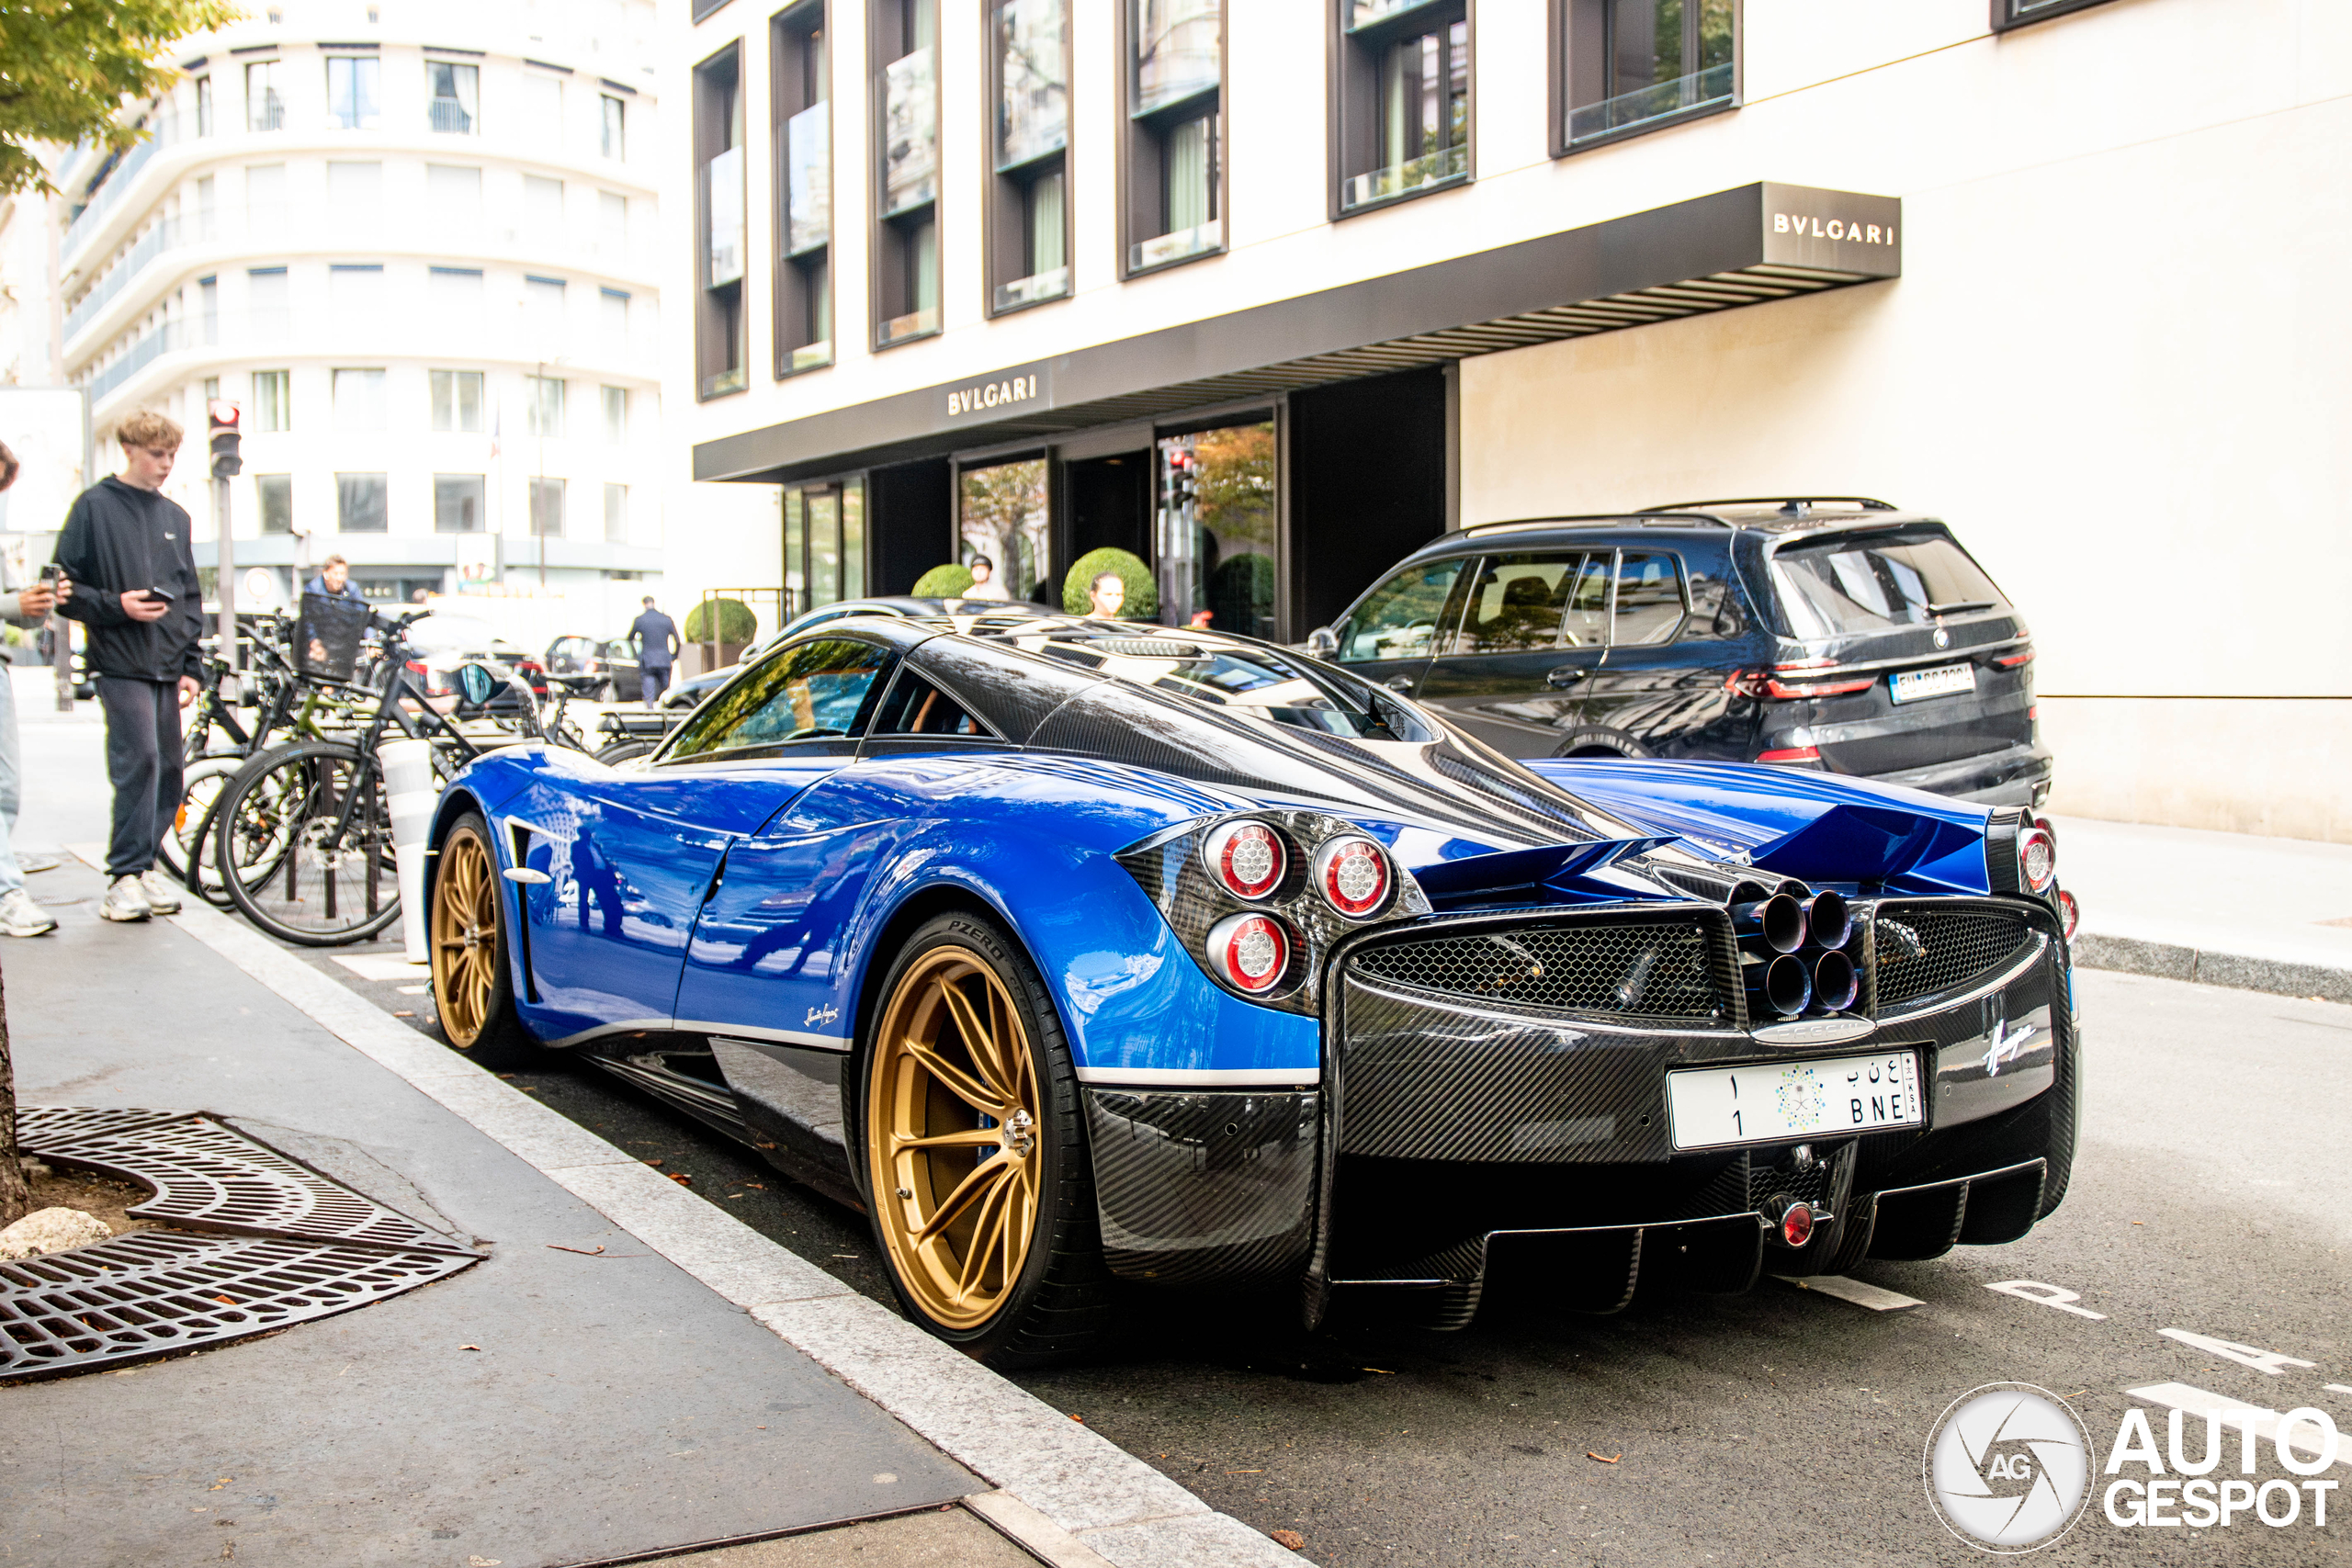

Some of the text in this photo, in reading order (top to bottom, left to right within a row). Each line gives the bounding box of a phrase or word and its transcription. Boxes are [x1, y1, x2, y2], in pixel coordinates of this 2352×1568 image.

[1774, 213, 1894, 245] BVLGARI
[948, 375, 1036, 416] BVLGARI
[1776, 1022, 1859, 1041] PAGANI
[1732, 1094, 1904, 1136] 1 BNE
